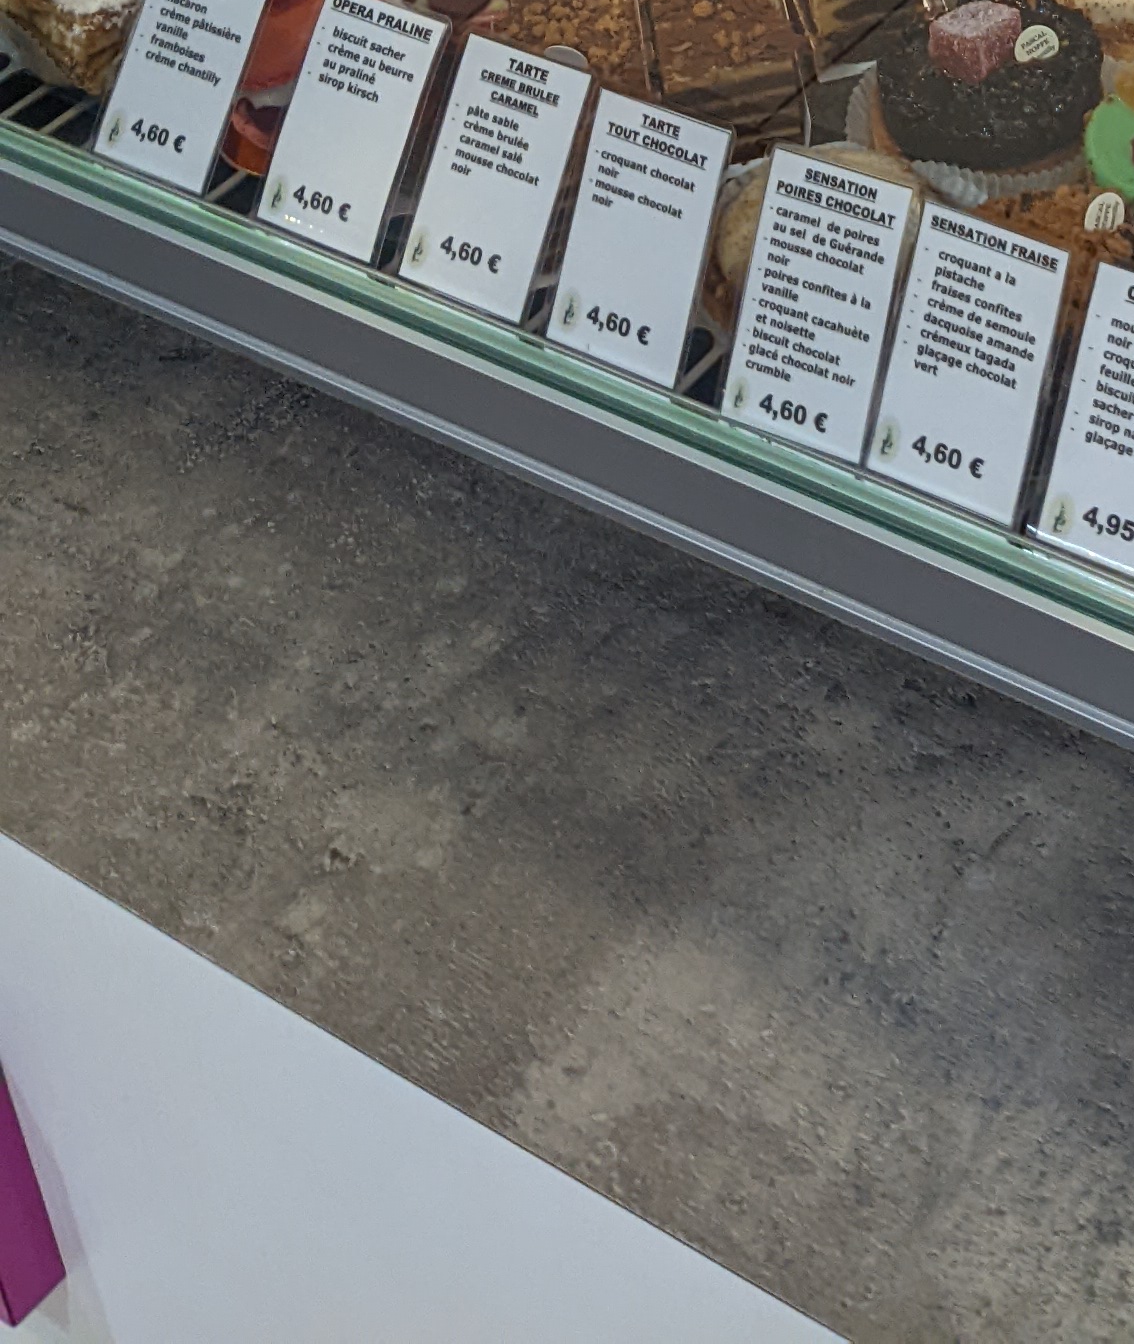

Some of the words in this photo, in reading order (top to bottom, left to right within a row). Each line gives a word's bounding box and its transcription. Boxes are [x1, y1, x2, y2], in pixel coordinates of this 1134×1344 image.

[332, 25, 368, 48] biscuit
[369, 42, 406, 61] sacher
[376, 11, 432, 41] PRALINE
[150, 33, 205, 62] framboises
[480, 68, 516, 90] CREME
[517, 82, 560, 105] BRULEE
[508, 57, 549, 83] TARTE
[489, 90, 538, 117] CARAMEL
[130, 118, 169, 146] 4,60
[172, 134, 186, 153] €
[607, 120, 640, 143] TOUT
[642, 134, 708, 167] CHOCOLAT
[641, 113, 680, 138] TARTE
[454, 148, 493, 169] mousse
[495, 162, 539, 186] chocolat
[600, 150, 647, 174] croquant
[649, 167, 695, 192] chocolat
[804, 168, 877, 201] SENSATION
[292, 184, 333, 214] 4,60
[338, 202, 351, 222] €
[775, 179, 822, 205] POIRES
[824, 195, 896, 228] CHOCOLAT
[775, 206, 821, 227] caramel
[826, 221, 840, 234] de
[843, 228, 879, 246] poires
[930, 214, 1007, 253] SENSATION
[1009, 242, 1058, 271] FRAISE
[439, 235, 482, 266] 4,60
[487, 253, 501, 274] €
[769, 236, 812, 258] mousse
[815, 251, 864, 275] chocolat
[931, 279, 971, 303] fraises
[974, 297, 1022, 322] confites
[586, 305, 630, 336] 4,60
[636, 325, 650, 345] €
[927, 297, 964, 317] crème
[966, 311, 982, 324] de
[984, 319, 1035, 345] semoule
[1106, 333, 1132, 349] noir
[758, 393, 806, 425] 4,60
[813, 412, 828, 433] €
[911, 435, 962, 469] 4,60
[968, 457, 984, 478] €
[1084, 430, 1133, 456] glaçage
